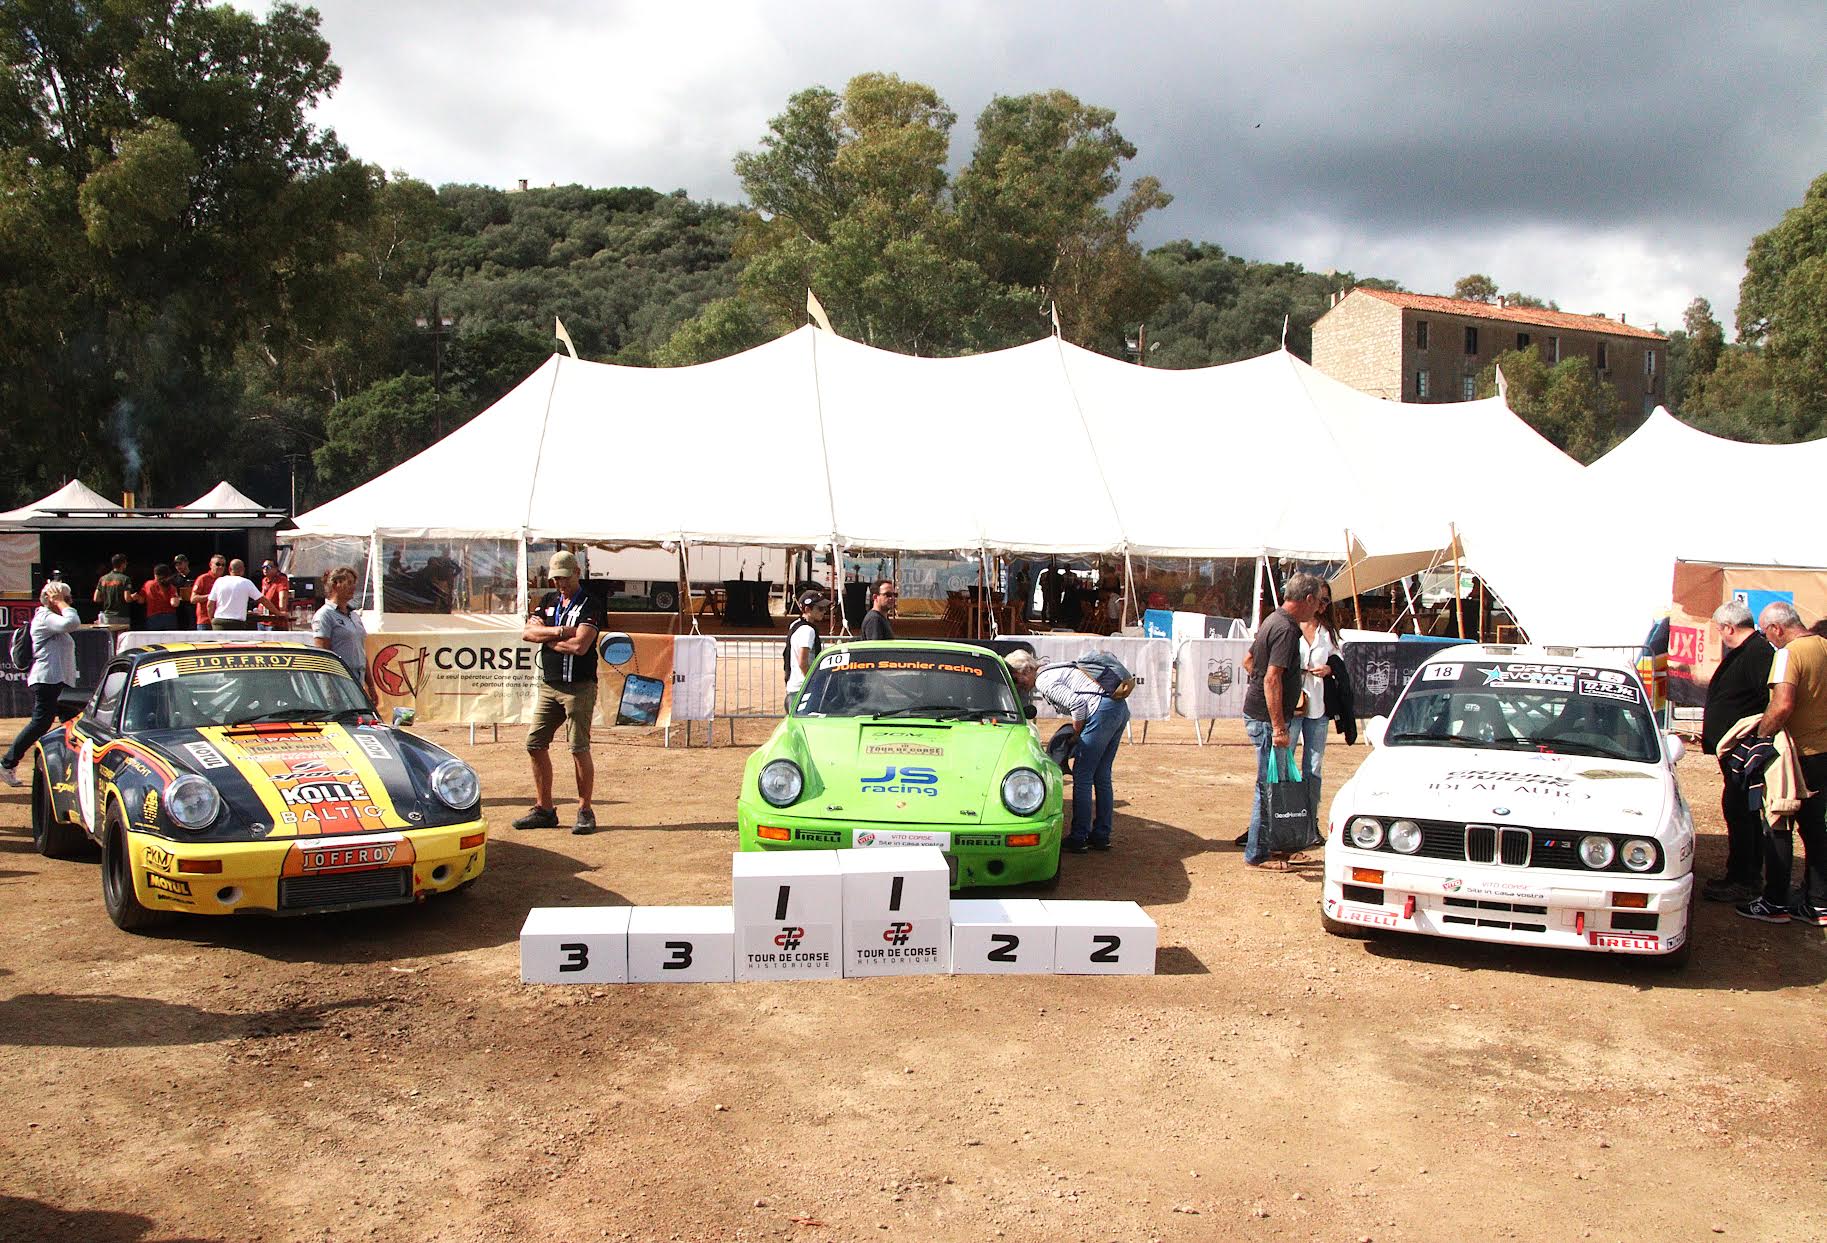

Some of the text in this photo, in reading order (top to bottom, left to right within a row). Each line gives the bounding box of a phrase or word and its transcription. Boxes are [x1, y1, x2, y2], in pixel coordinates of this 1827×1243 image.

[199, 656, 293, 666] JOFFROY
[826, 655, 842, 665] 10
[152, 668, 161, 678] 1
[878, 661, 935, 670] Saunier
[938, 663, 983, 677] racing
[1434, 667, 1453, 678] 18
[1506, 663, 1597, 677] ORECA
[512, 673, 523, 682] qui
[188, 743, 223, 767] MOTUL
[909, 747, 941, 755] CORSE
[270, 770, 356, 782] spark
[860, 766, 938, 784] JS
[280, 782, 370, 805] KOLLÉ
[862, 784, 938, 797] racing
[280, 805, 386, 825] BALTIC
[795, 828, 841, 843] PIRELLI
[955, 834, 1001, 847] PIRELLI
[303, 846, 396, 867] JOFFROY
[150, 874, 189, 894] MOTUL
[1442, 879, 1463, 891] VITO
[1589, 931, 1659, 951] PIRELLI
[857, 947, 937, 958] TOUR DE CORSE
[987, 934, 1020, 963] 2
[1089, 935, 1121, 963] 2
[559, 943, 589, 972] 3
[662, 941, 694, 970] 3
[748, 952, 829, 963] TOUR DE CORSE
[857, 956, 938, 965] HISTORIQUE
[748, 961, 830, 969] HISTORIQUE
